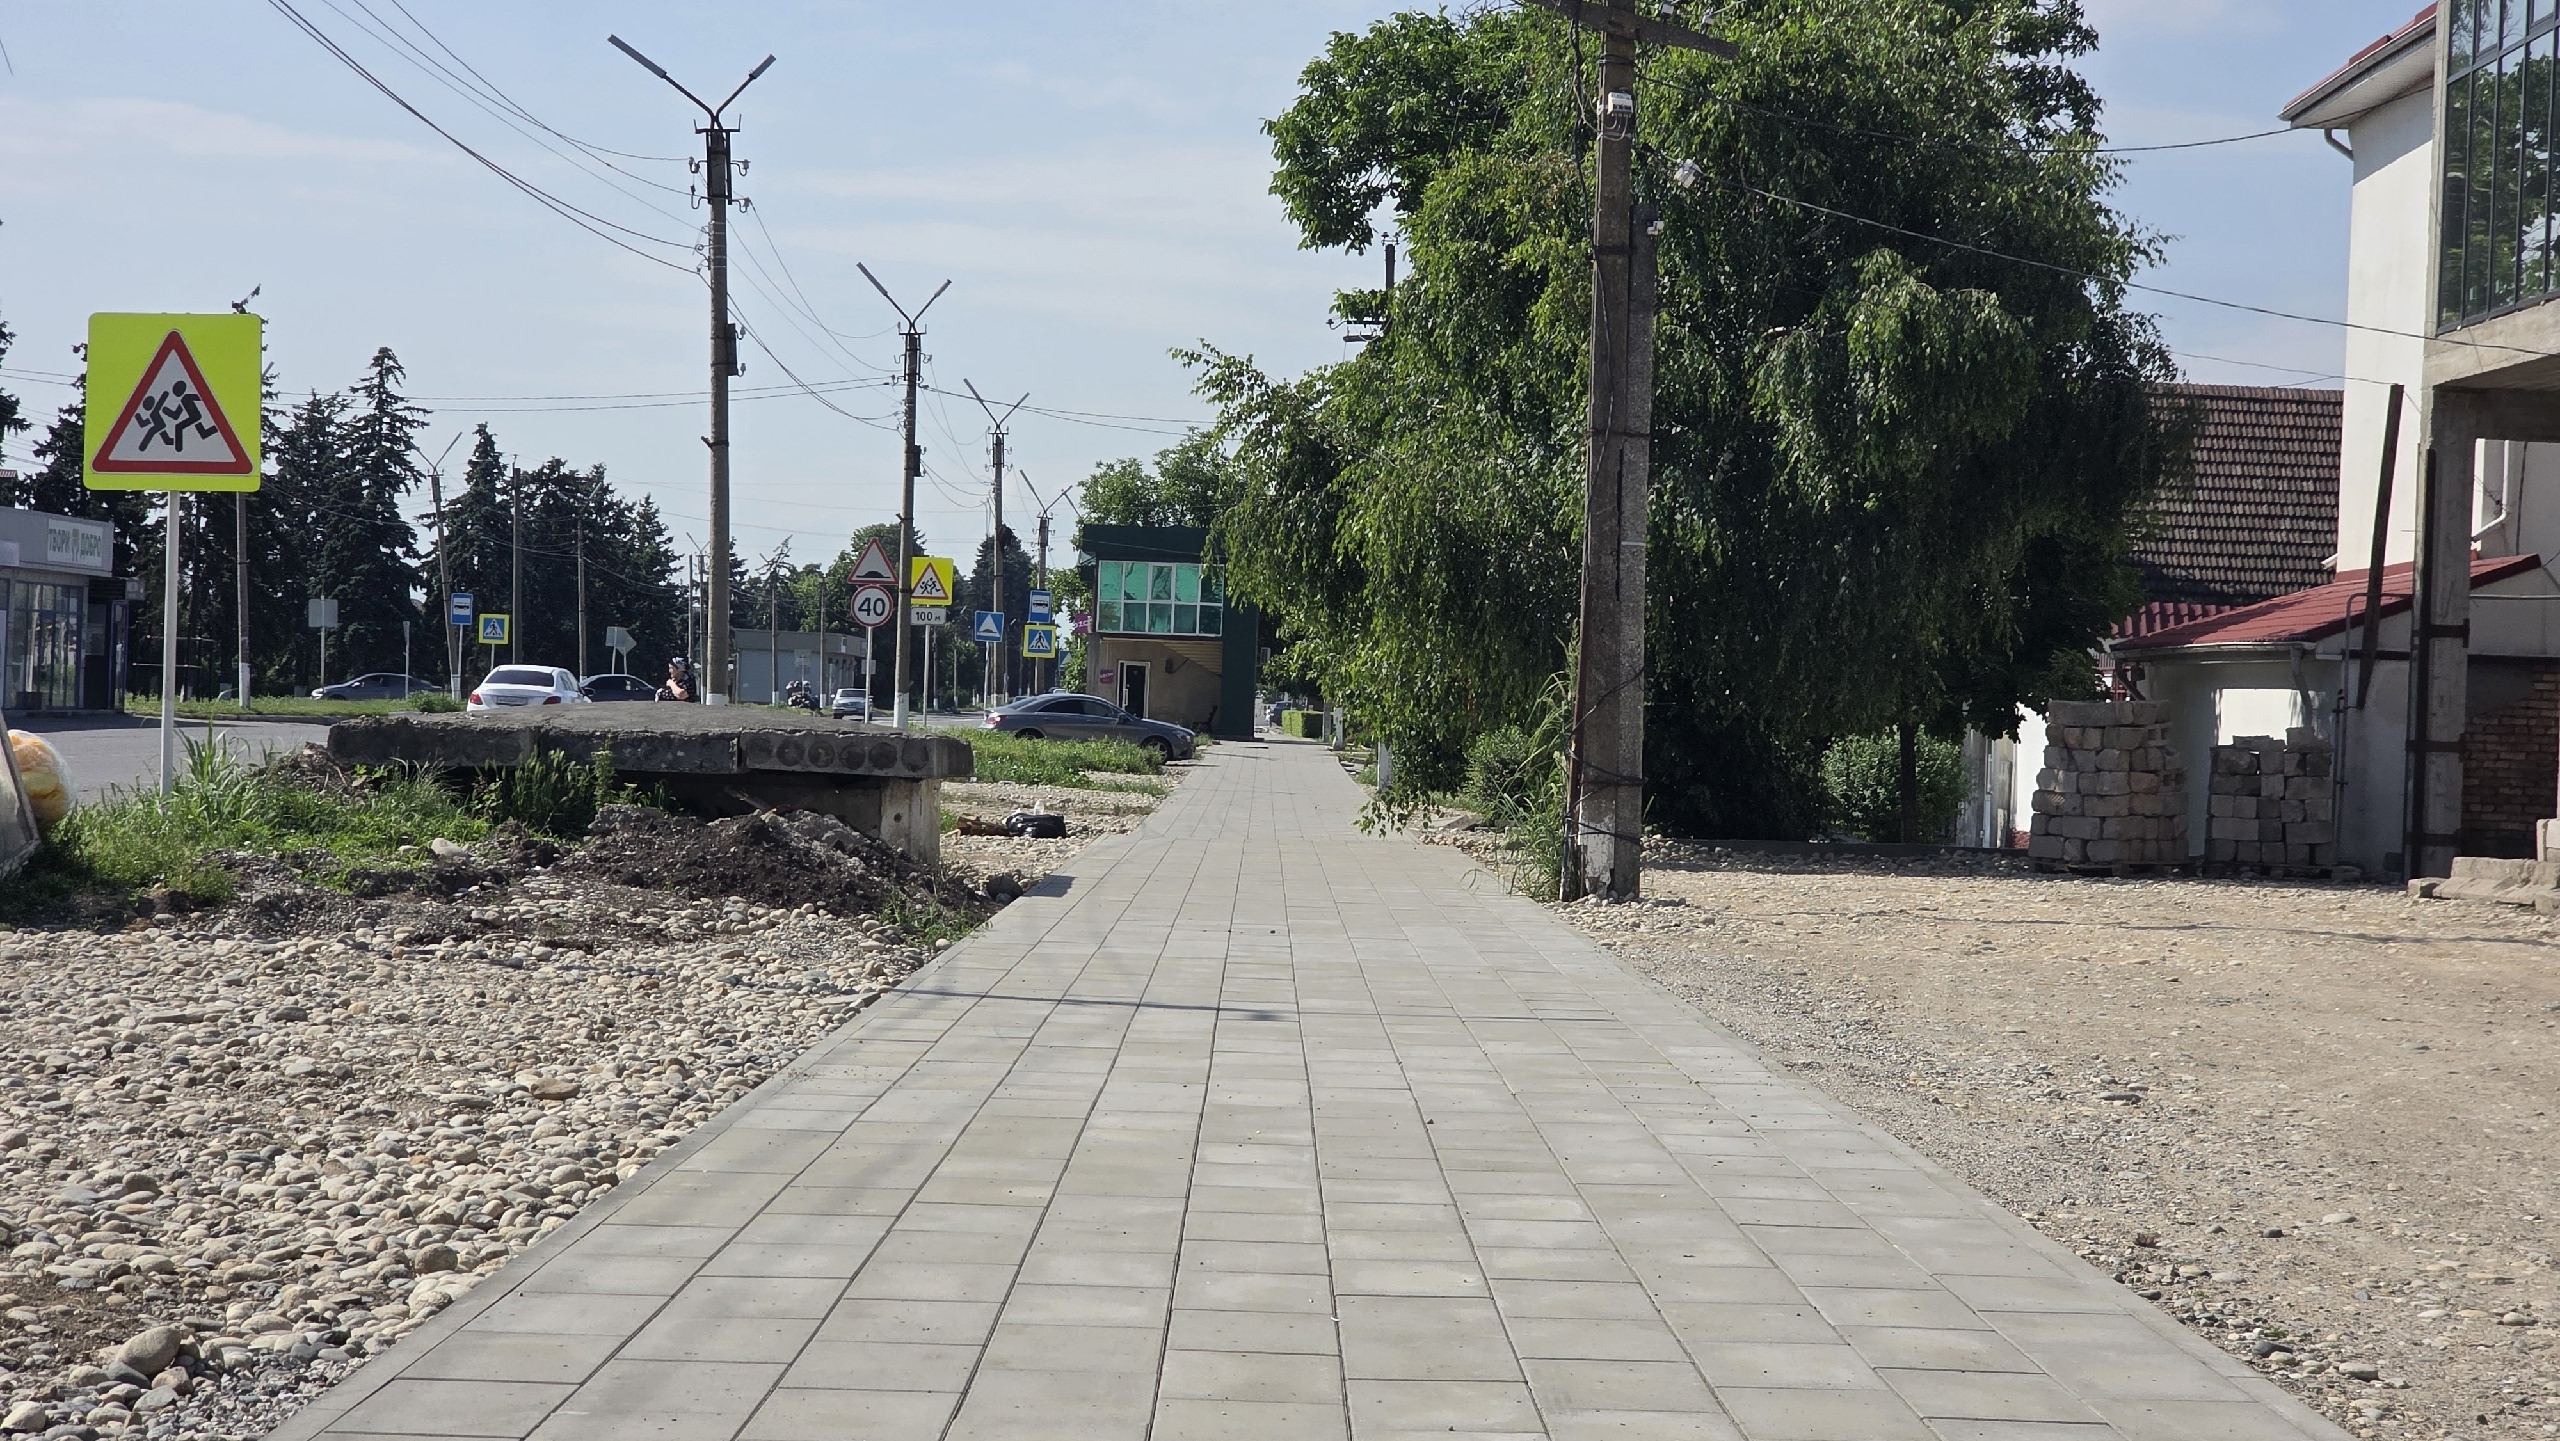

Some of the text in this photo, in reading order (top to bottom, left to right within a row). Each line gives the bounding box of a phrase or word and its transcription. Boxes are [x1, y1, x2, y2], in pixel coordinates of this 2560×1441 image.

[49, 528, 101, 559] ТВОРИ ДОБРО
[858, 597, 886, 617] 40
[915, 611, 933, 622] 100
